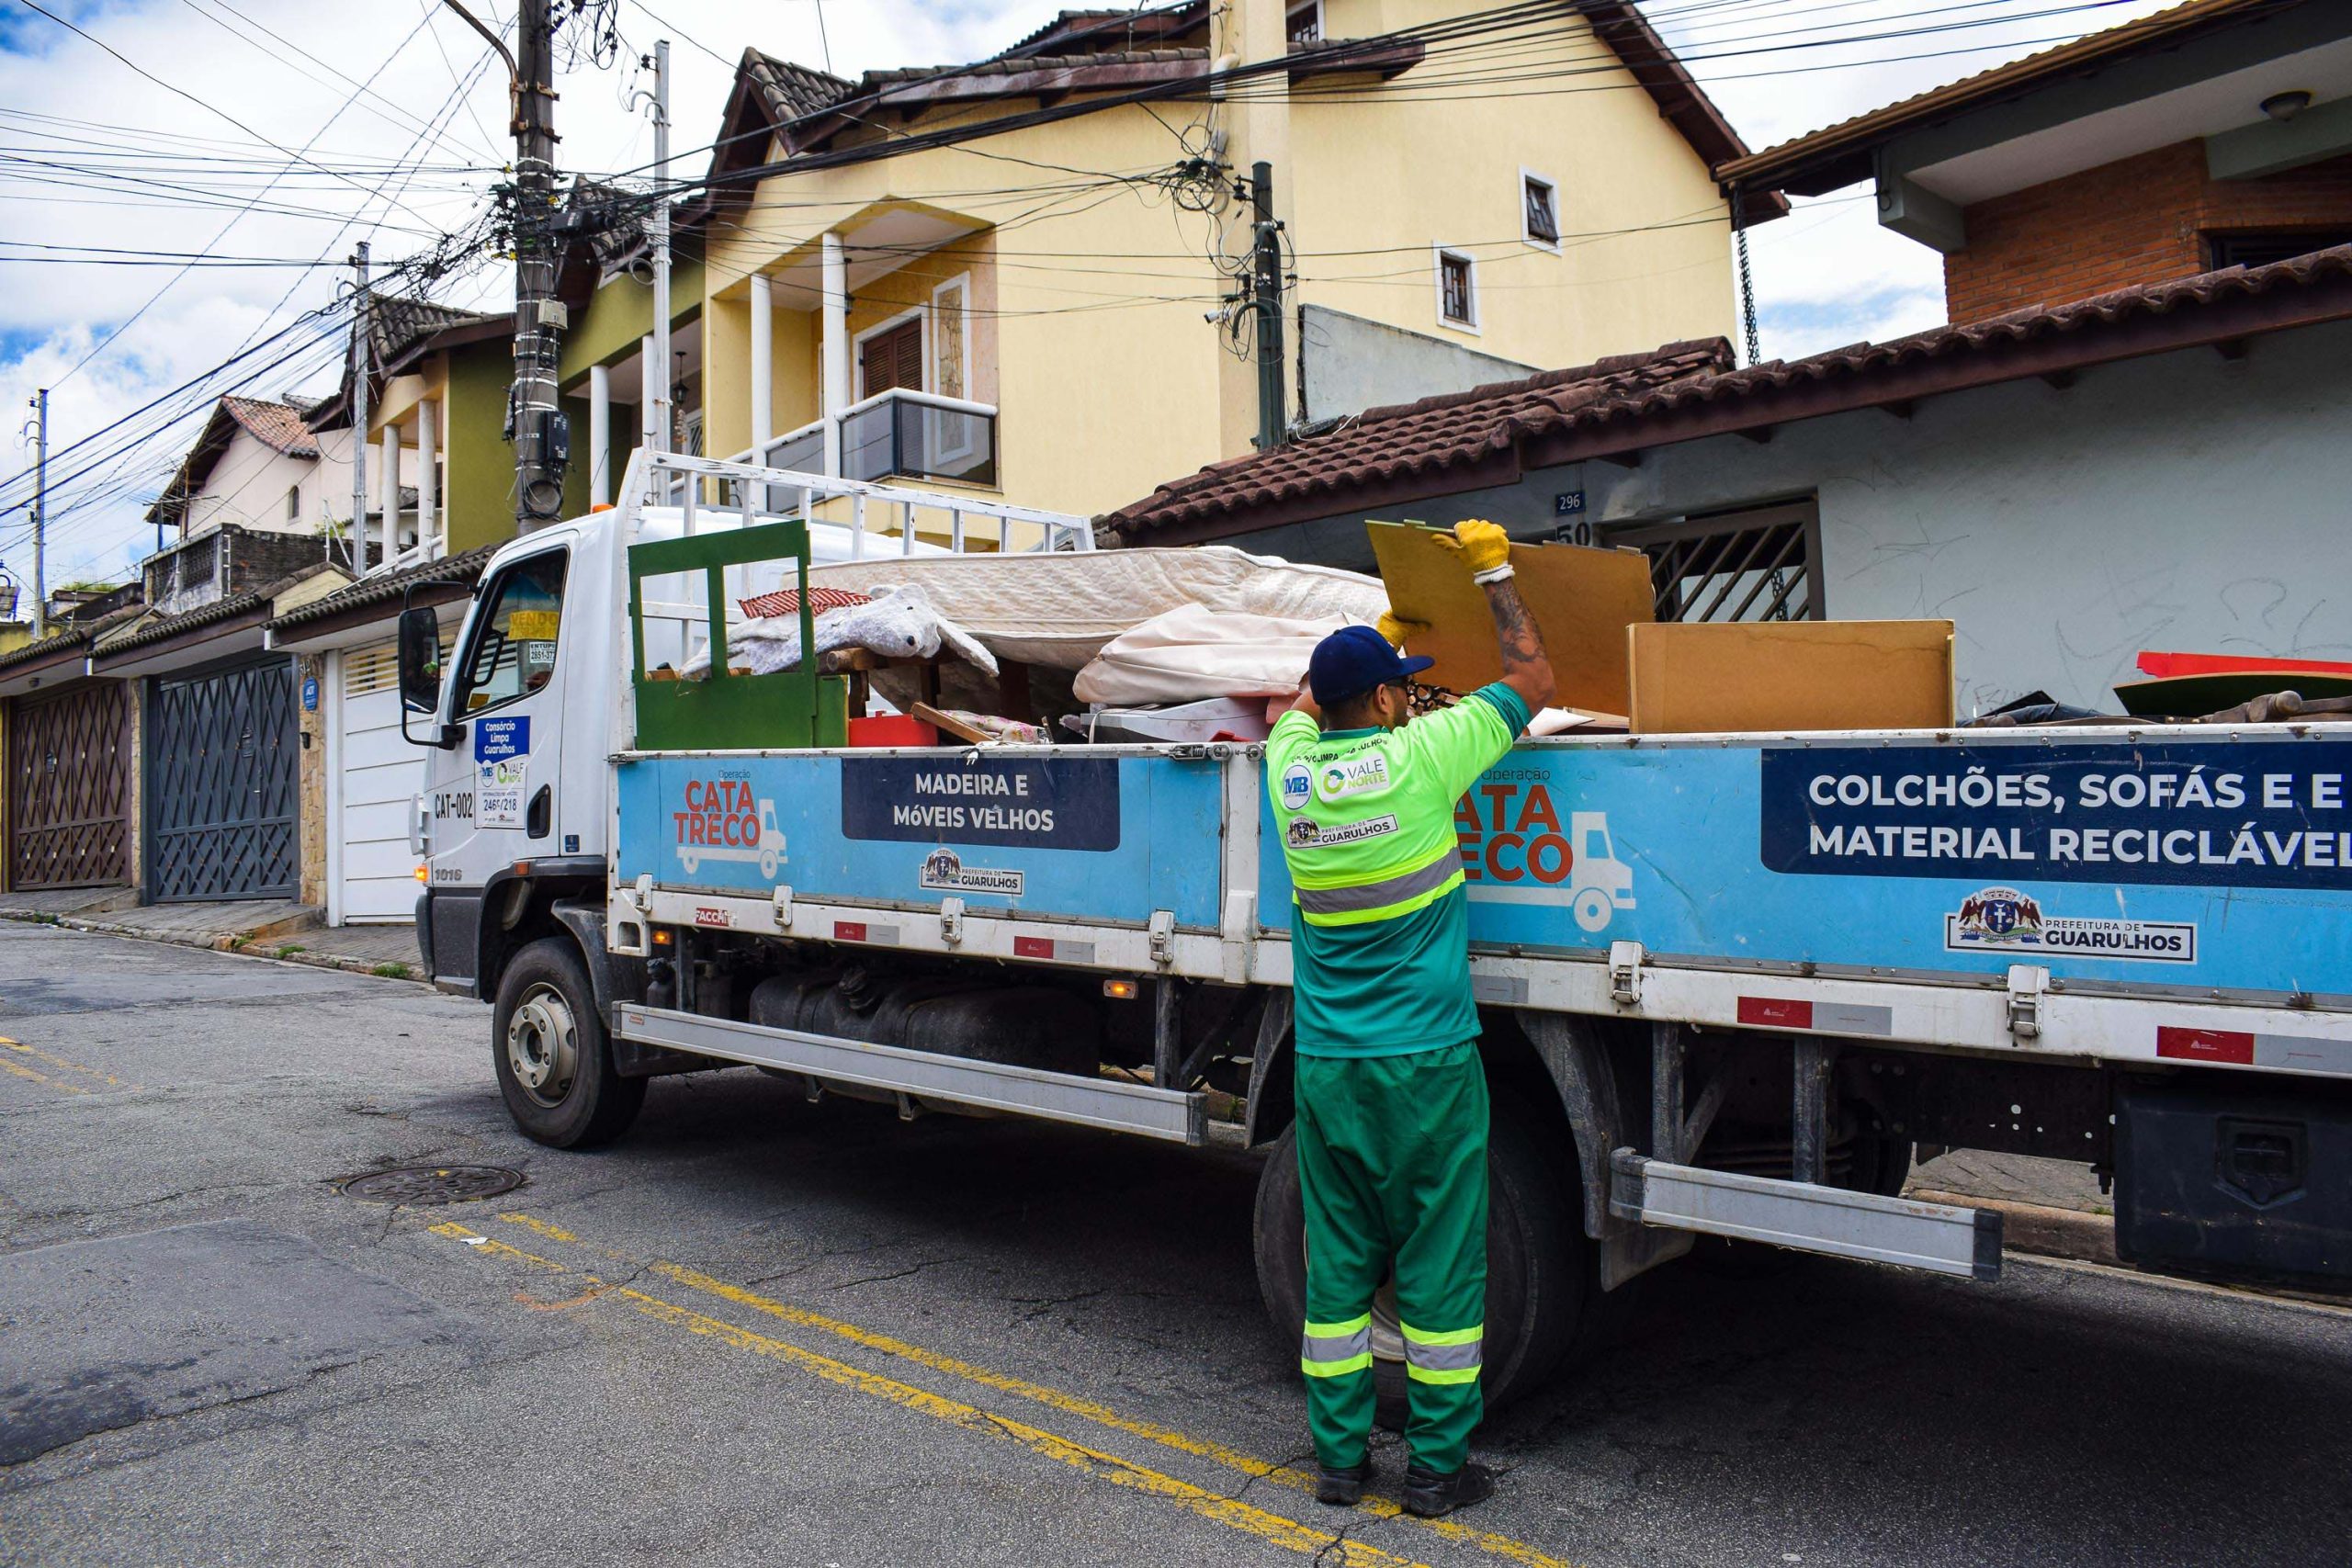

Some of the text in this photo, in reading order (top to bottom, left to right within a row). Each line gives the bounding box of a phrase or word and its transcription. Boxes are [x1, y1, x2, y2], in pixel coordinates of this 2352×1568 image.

[1560, 494, 1580, 510] 296
[485, 720, 515, 732] Consórcio
[490, 732, 510, 745] Limpa
[484, 744, 515, 754] Guarulhos
[718, 769, 751, 780] Operação
[1347, 759, 1384, 779] VALE
[1481, 768, 1551, 784] Operação
[915, 773, 1029, 796] MADEIRA E
[1347, 773, 1387, 789] NORTE
[1809, 766, 2065, 814] COLCHÕES,
[2079, 765, 2245, 808] SOFÁS
[2263, 774, 2293, 808] E
[435, 793, 473, 818] CAT-002
[685, 780, 756, 814] CATA
[1454, 784, 1562, 833] ATA
[969, 807, 1055, 831] VELHOS
[1322, 823, 1356, 833] PREFEITURA
[673, 812, 761, 847] TRECO
[1322, 822, 1390, 842] GUARULHOS
[1810, 821, 2352, 867] MATERIAL RECICLÁVEL
[1459, 832, 1573, 884] ECO
[962, 875, 1018, 889] GUARULHOS
[2046, 919, 2140, 931] PREFEITURA DE
[2046, 930, 2182, 951] GUARULHOS
